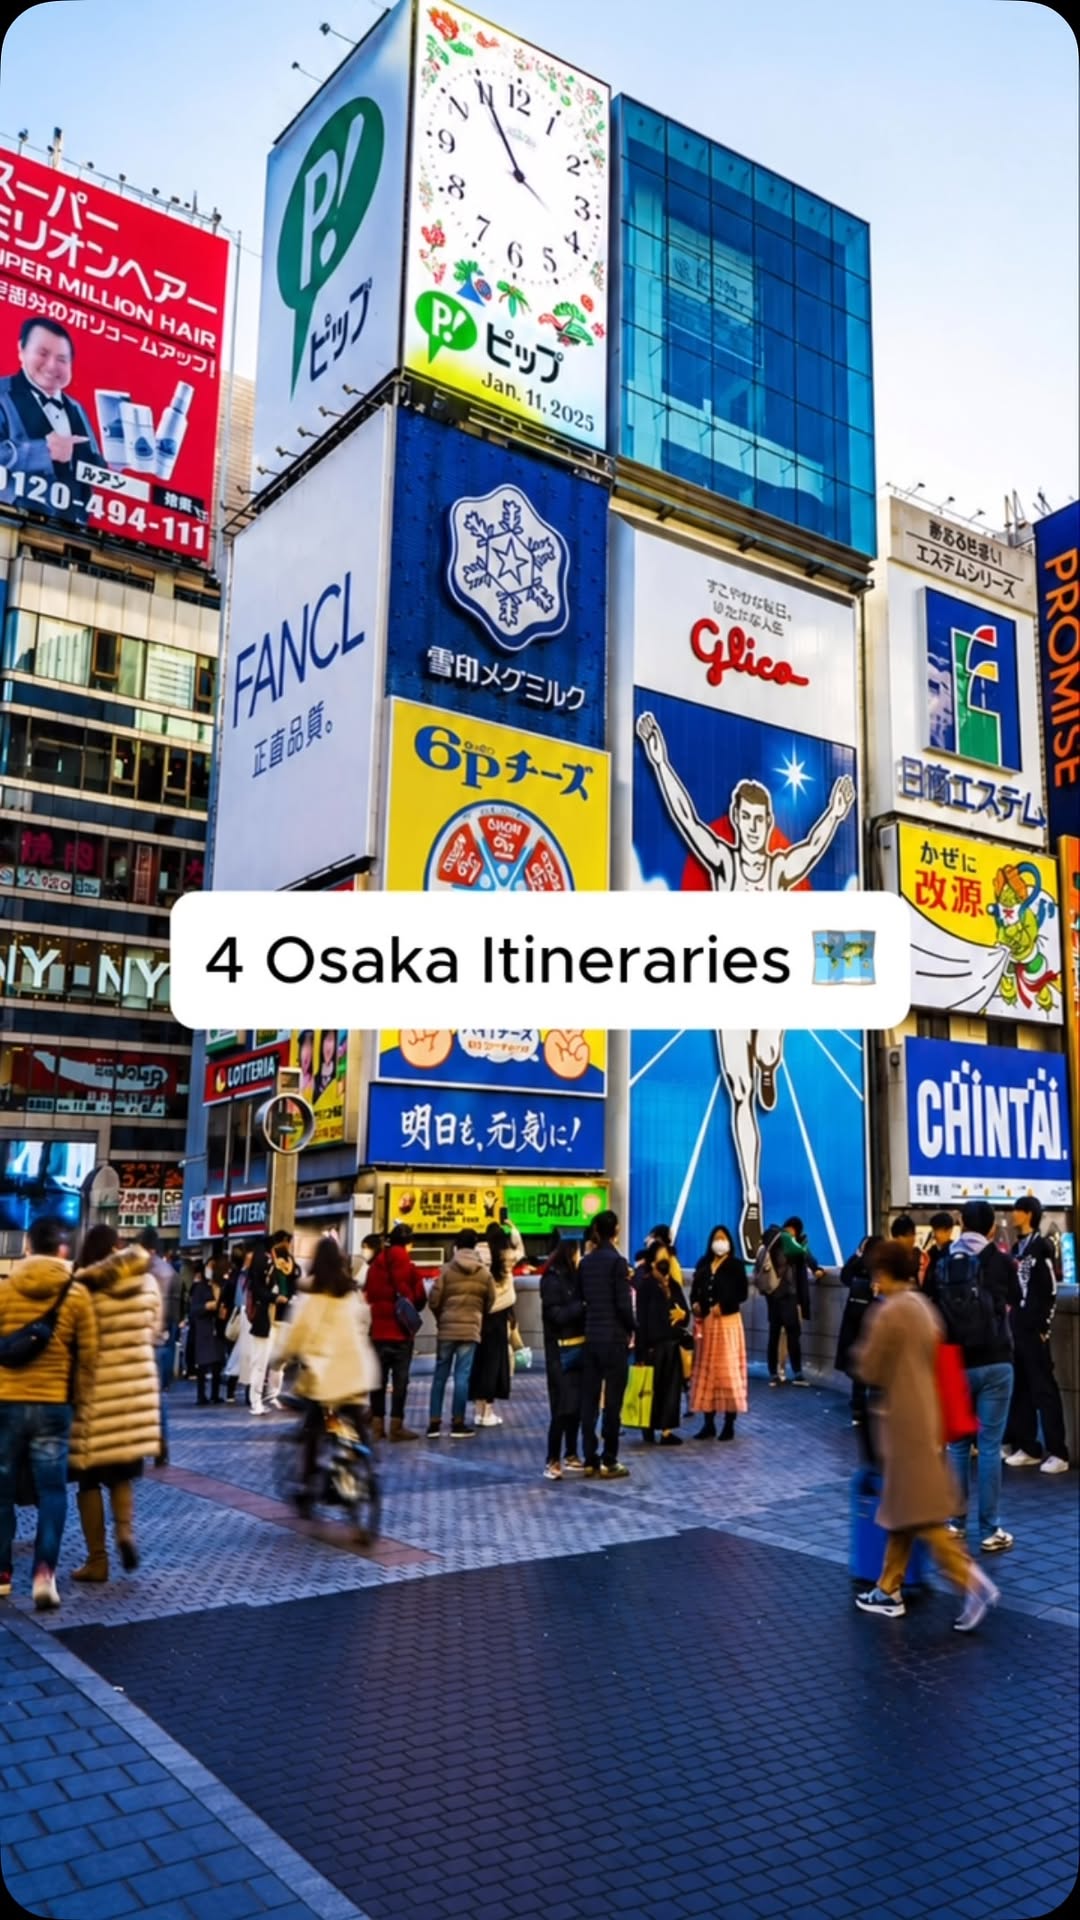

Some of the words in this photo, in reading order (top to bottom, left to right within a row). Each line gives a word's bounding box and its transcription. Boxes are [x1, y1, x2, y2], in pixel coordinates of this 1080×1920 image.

[508, 83, 532, 117] 12
[438, 128, 456, 154] 9
[565, 154, 582, 177] 2
[447, 174, 466, 200] 8
[574, 194, 591, 221] 3
[476, 214, 491, 242] 7
[563, 230, 581, 254] 4
[507, 240, 524, 269] 6
[542, 246, 557, 274] 5
[58, 271, 154, 326] MILLION
[159, 313, 217, 350] HAIR
[310, 277, 373, 382] ピップ
[486, 321, 564, 384] ピップ
[481, 371, 522, 402] Jan.
[550, 398, 595, 433] 2025
[915, 543, 1016, 600] エステムシリーズ
[232, 571, 365, 729] FANCL
[689, 617, 810, 687] Glico
[427, 645, 586, 712] 雪印メグミルク
[1045, 547, 1080, 788] PROMISE
[920, 841, 977, 874] かぜに
[915, 869, 985, 919] 改源
[227, 1055, 275, 1088] LOTTERIA
